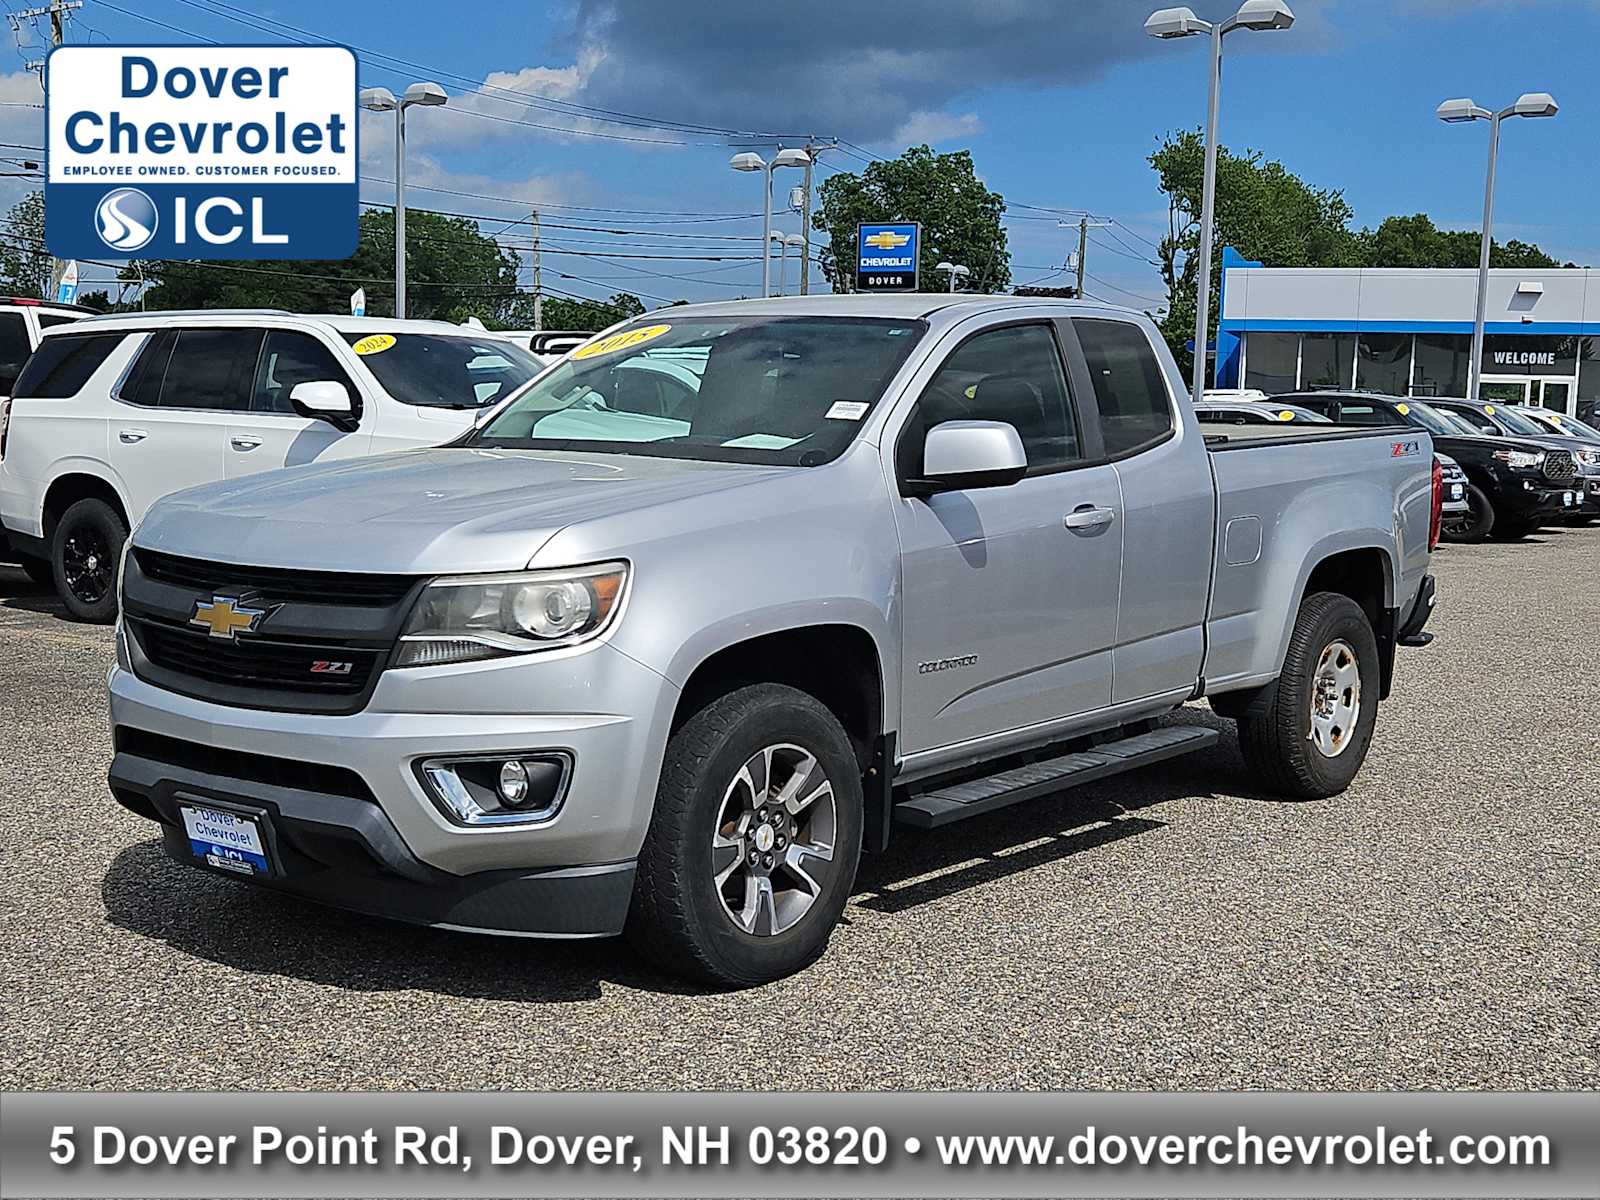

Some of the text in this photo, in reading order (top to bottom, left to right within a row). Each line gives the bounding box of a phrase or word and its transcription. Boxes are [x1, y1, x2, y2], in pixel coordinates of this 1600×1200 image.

[860, 257, 913, 267] CHEVROLET
[868, 276, 903, 286] DOVER
[355, 335, 388, 353] 2024
[1494, 351, 1555, 365] WELCOME
[1390, 441, 1420, 457] Z71
[310, 660, 353, 674] Z71
[200, 808, 236, 827] Dover
[195, 822, 253, 846] Chevrolet
